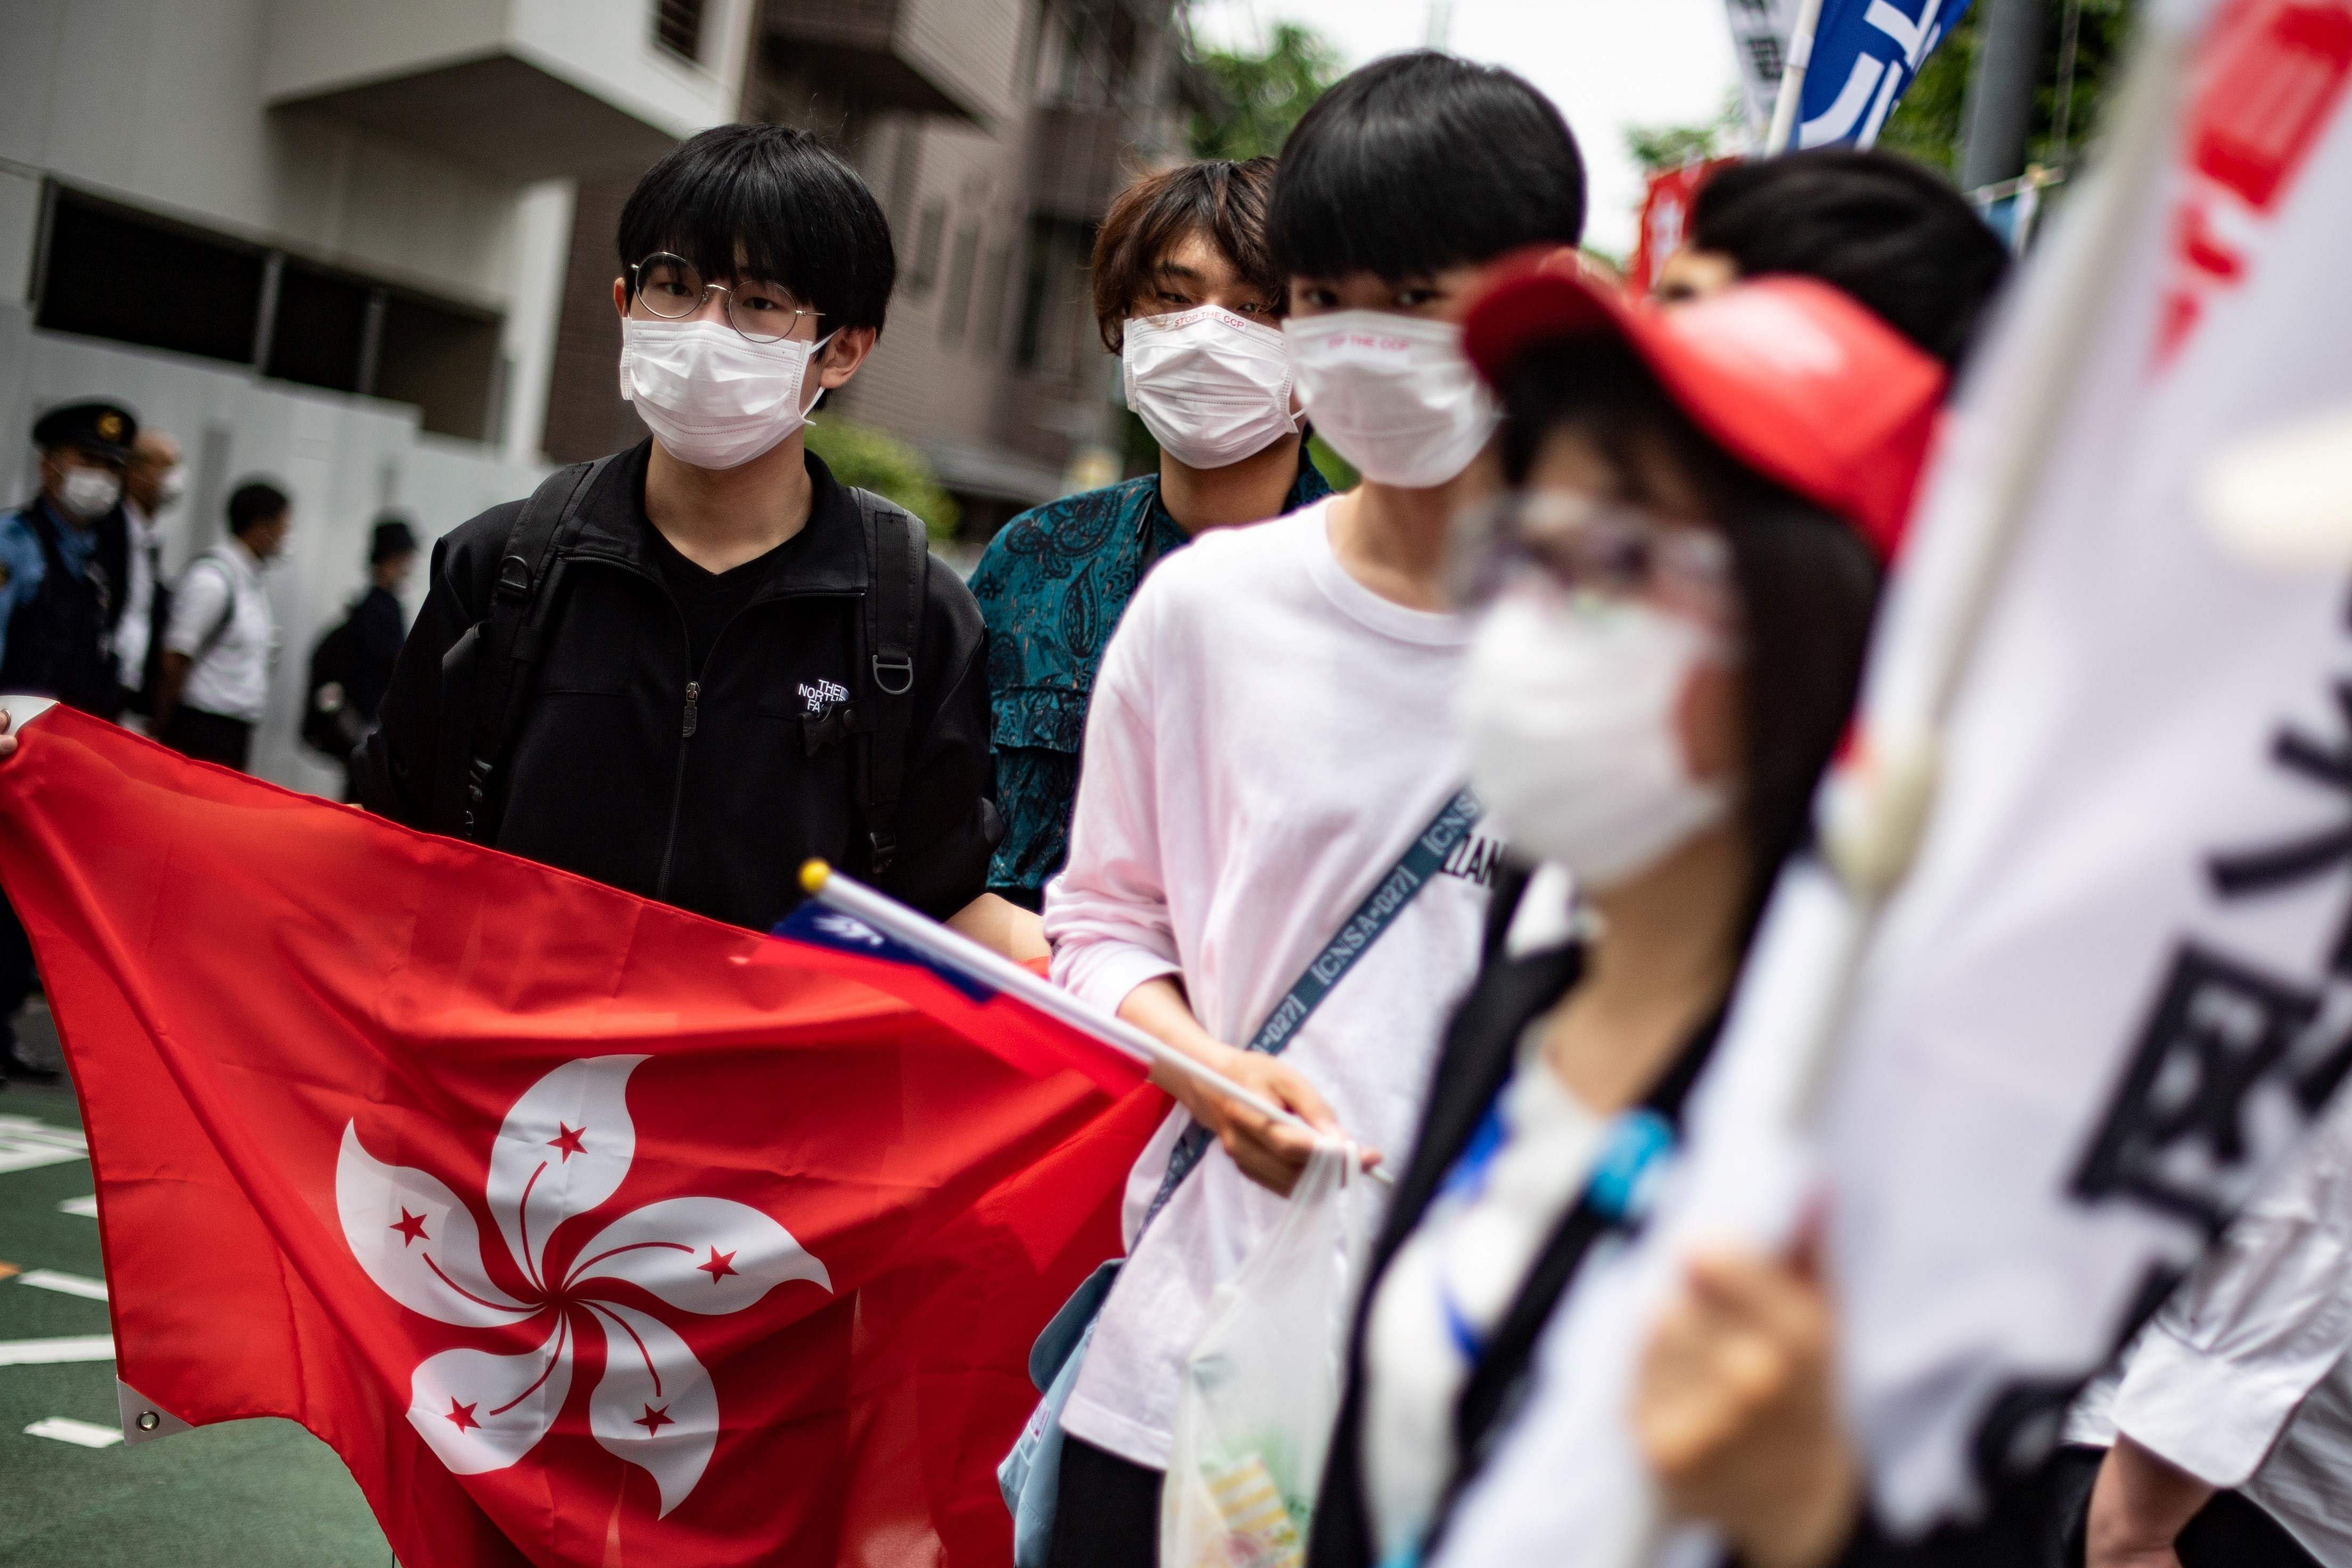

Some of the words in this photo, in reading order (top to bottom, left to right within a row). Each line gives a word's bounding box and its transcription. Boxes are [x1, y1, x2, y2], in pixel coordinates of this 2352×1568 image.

[1174, 314, 1198, 328] STOP
[1201, 311, 1221, 320] THE
[1223, 315, 1245, 329] CCP
[818, 680, 841, 696] THE
[807, 699, 823, 713] FA
[1422, 793, 1478, 856] [CNS
